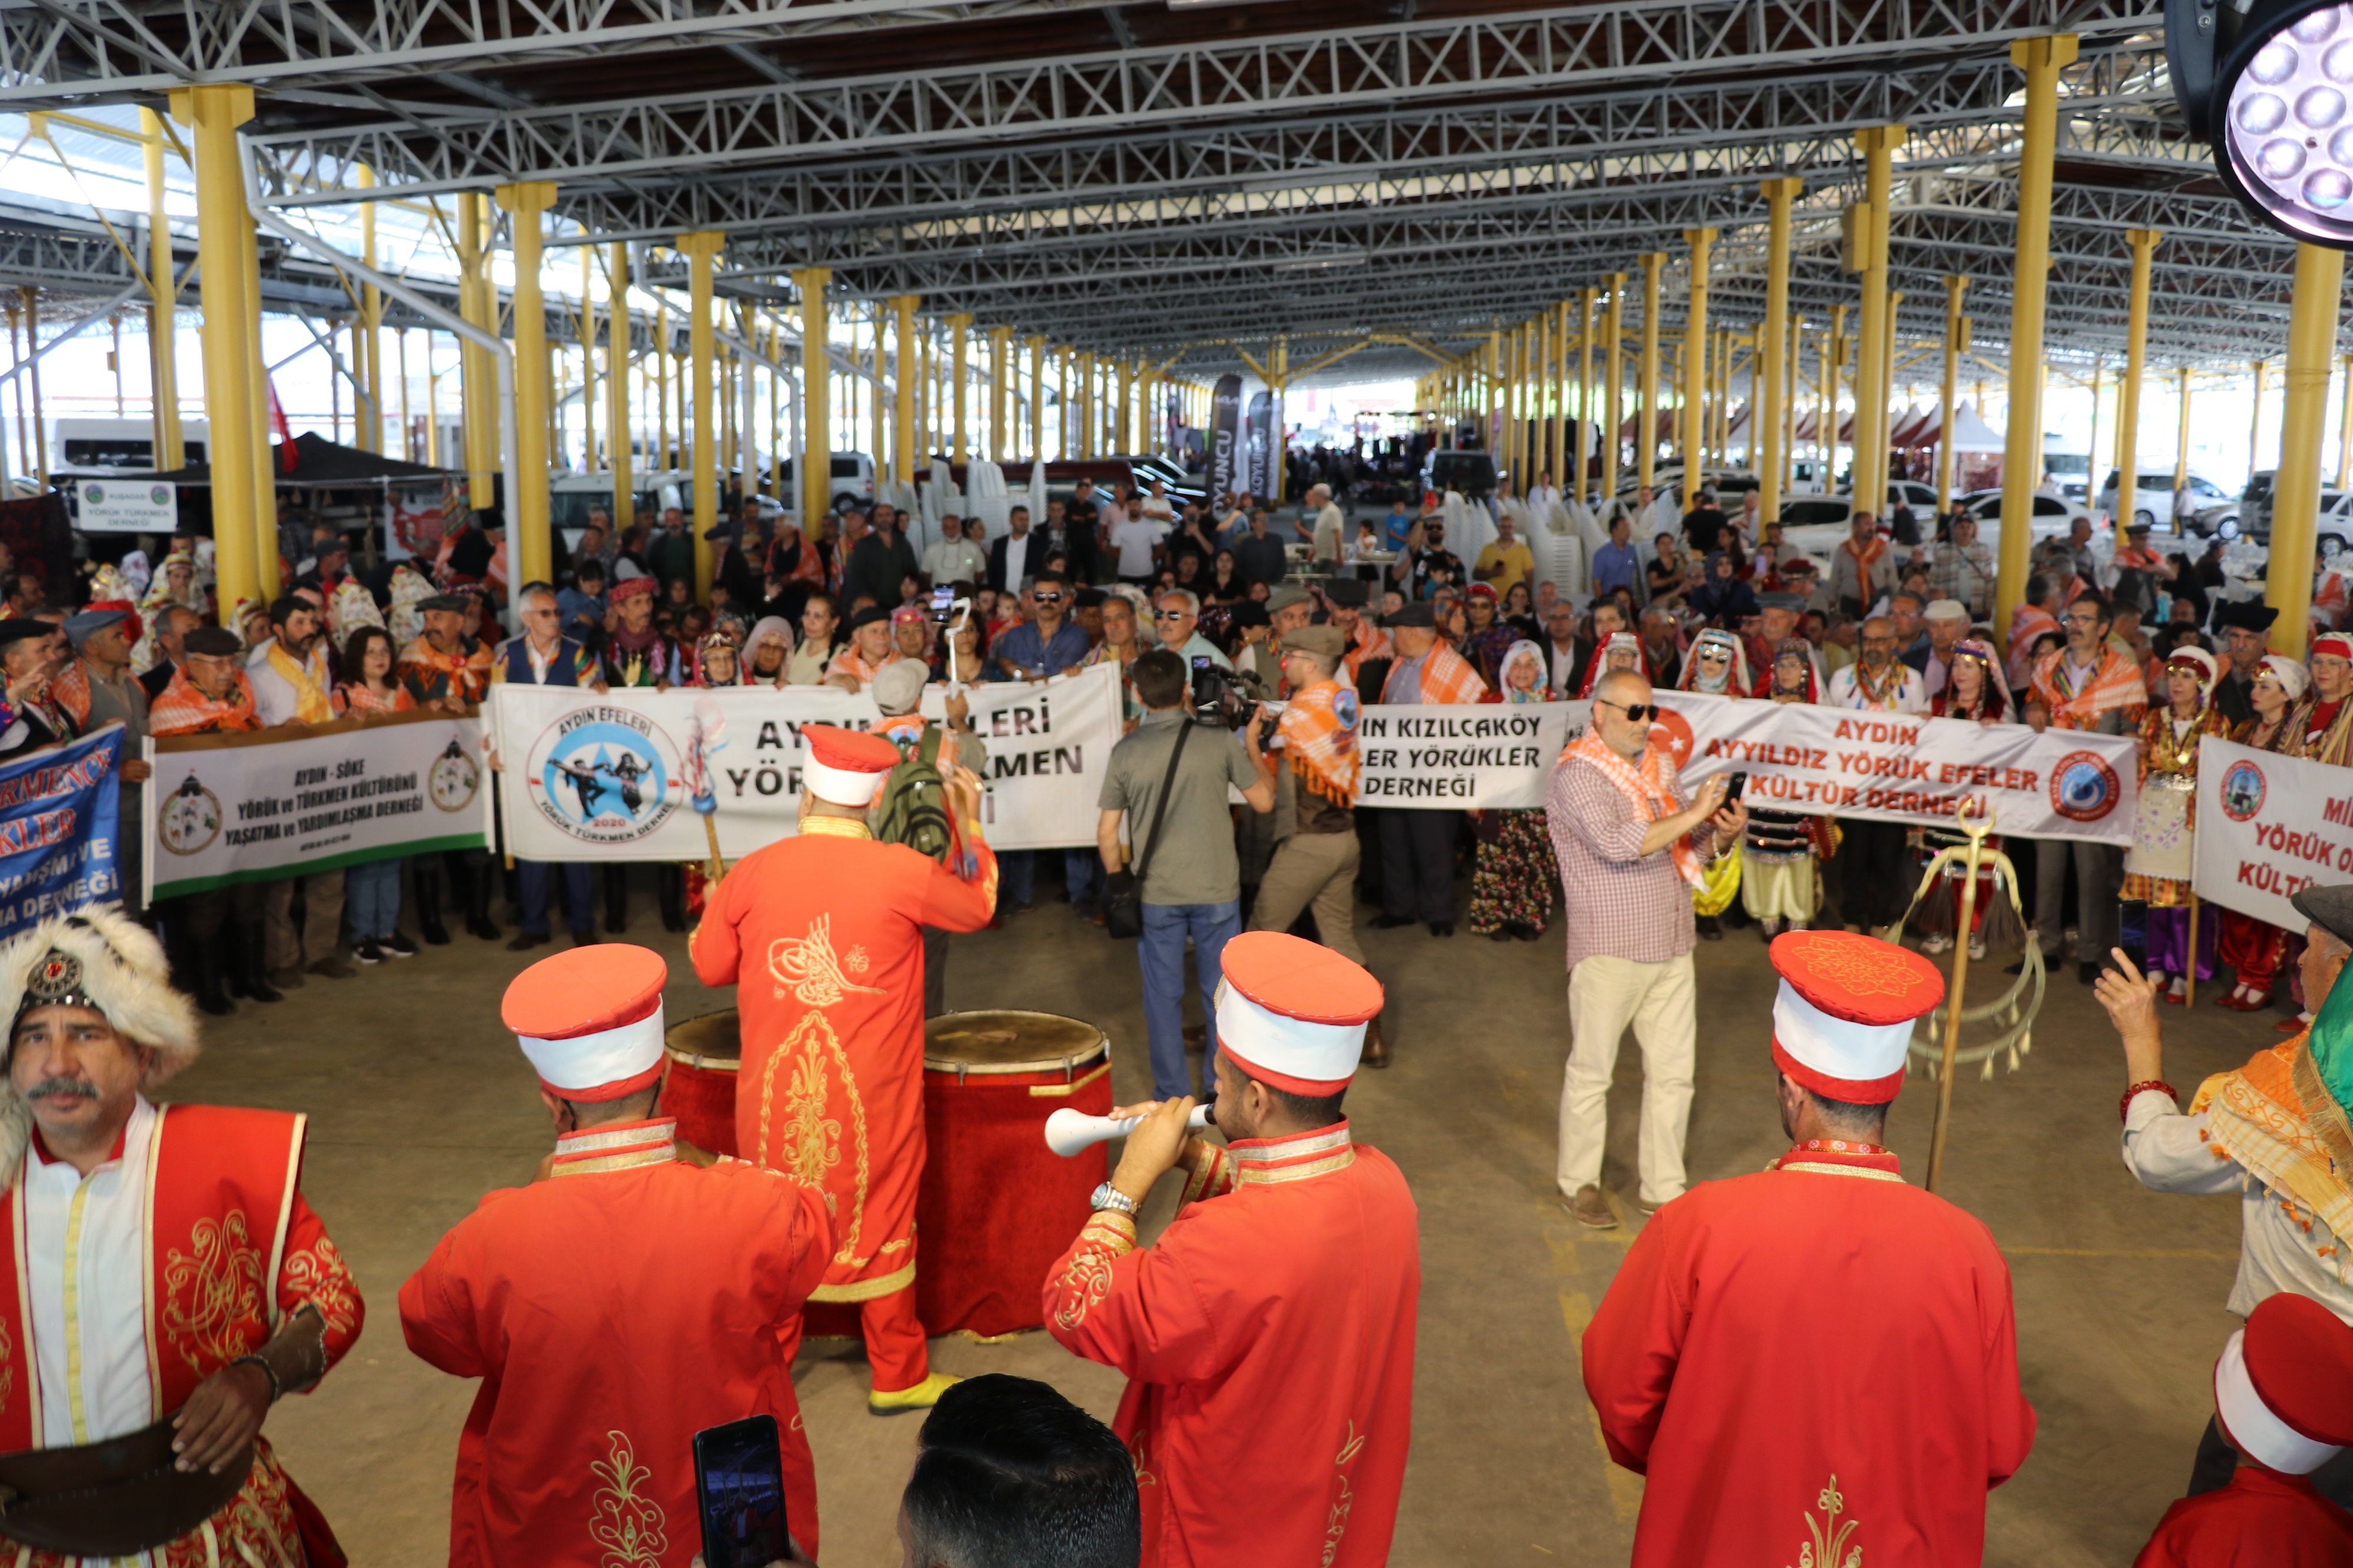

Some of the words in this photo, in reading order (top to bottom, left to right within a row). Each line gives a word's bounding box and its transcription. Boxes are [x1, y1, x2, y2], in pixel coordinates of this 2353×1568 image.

[88, 508, 121, 516] YÖRÜK
[559, 707, 595, 736] AYDIN
[599, 707, 652, 738] EFELERİ
[1397, 713, 1541, 739] KIZILCAKÖY
[1834, 718, 1919, 746] AYDIN
[1410, 744, 1541, 769] YÖRÜKLER
[1704, 738, 1828, 770] AYYILDIZ
[1837, 750, 1932, 782] YÖRÜK
[1939, 762, 2039, 792] EFELER
[295, 766, 328, 787] AYDIN
[336, 758, 366, 779] SÖKE
[1364, 773, 1476, 798] DERNEĞİ
[238, 796, 279, 820] YÖRÜK
[281, 798, 294, 814] ve
[296, 785, 349, 810] TÜRKMEN
[351, 771, 418, 800] KÜLTÜRÜNÜ
[1749, 773, 1860, 806] KÜLTÜR
[1865, 787, 1987, 820] DERNEĞİ
[225, 823, 281, 848] YAŞATMA
[283, 823, 295, 838] ve
[297, 803, 374, 835] YARDIMLAŞMA
[376, 794, 424, 818] DERNEĞİ
[541, 799, 572, 830] YÖRÜK
[575, 828, 635, 842] TÜRKMEN
[592, 818, 626, 828] 2020
[78, 837, 112, 862] VE
[2255, 822, 2337, 867] YÖRÜK
